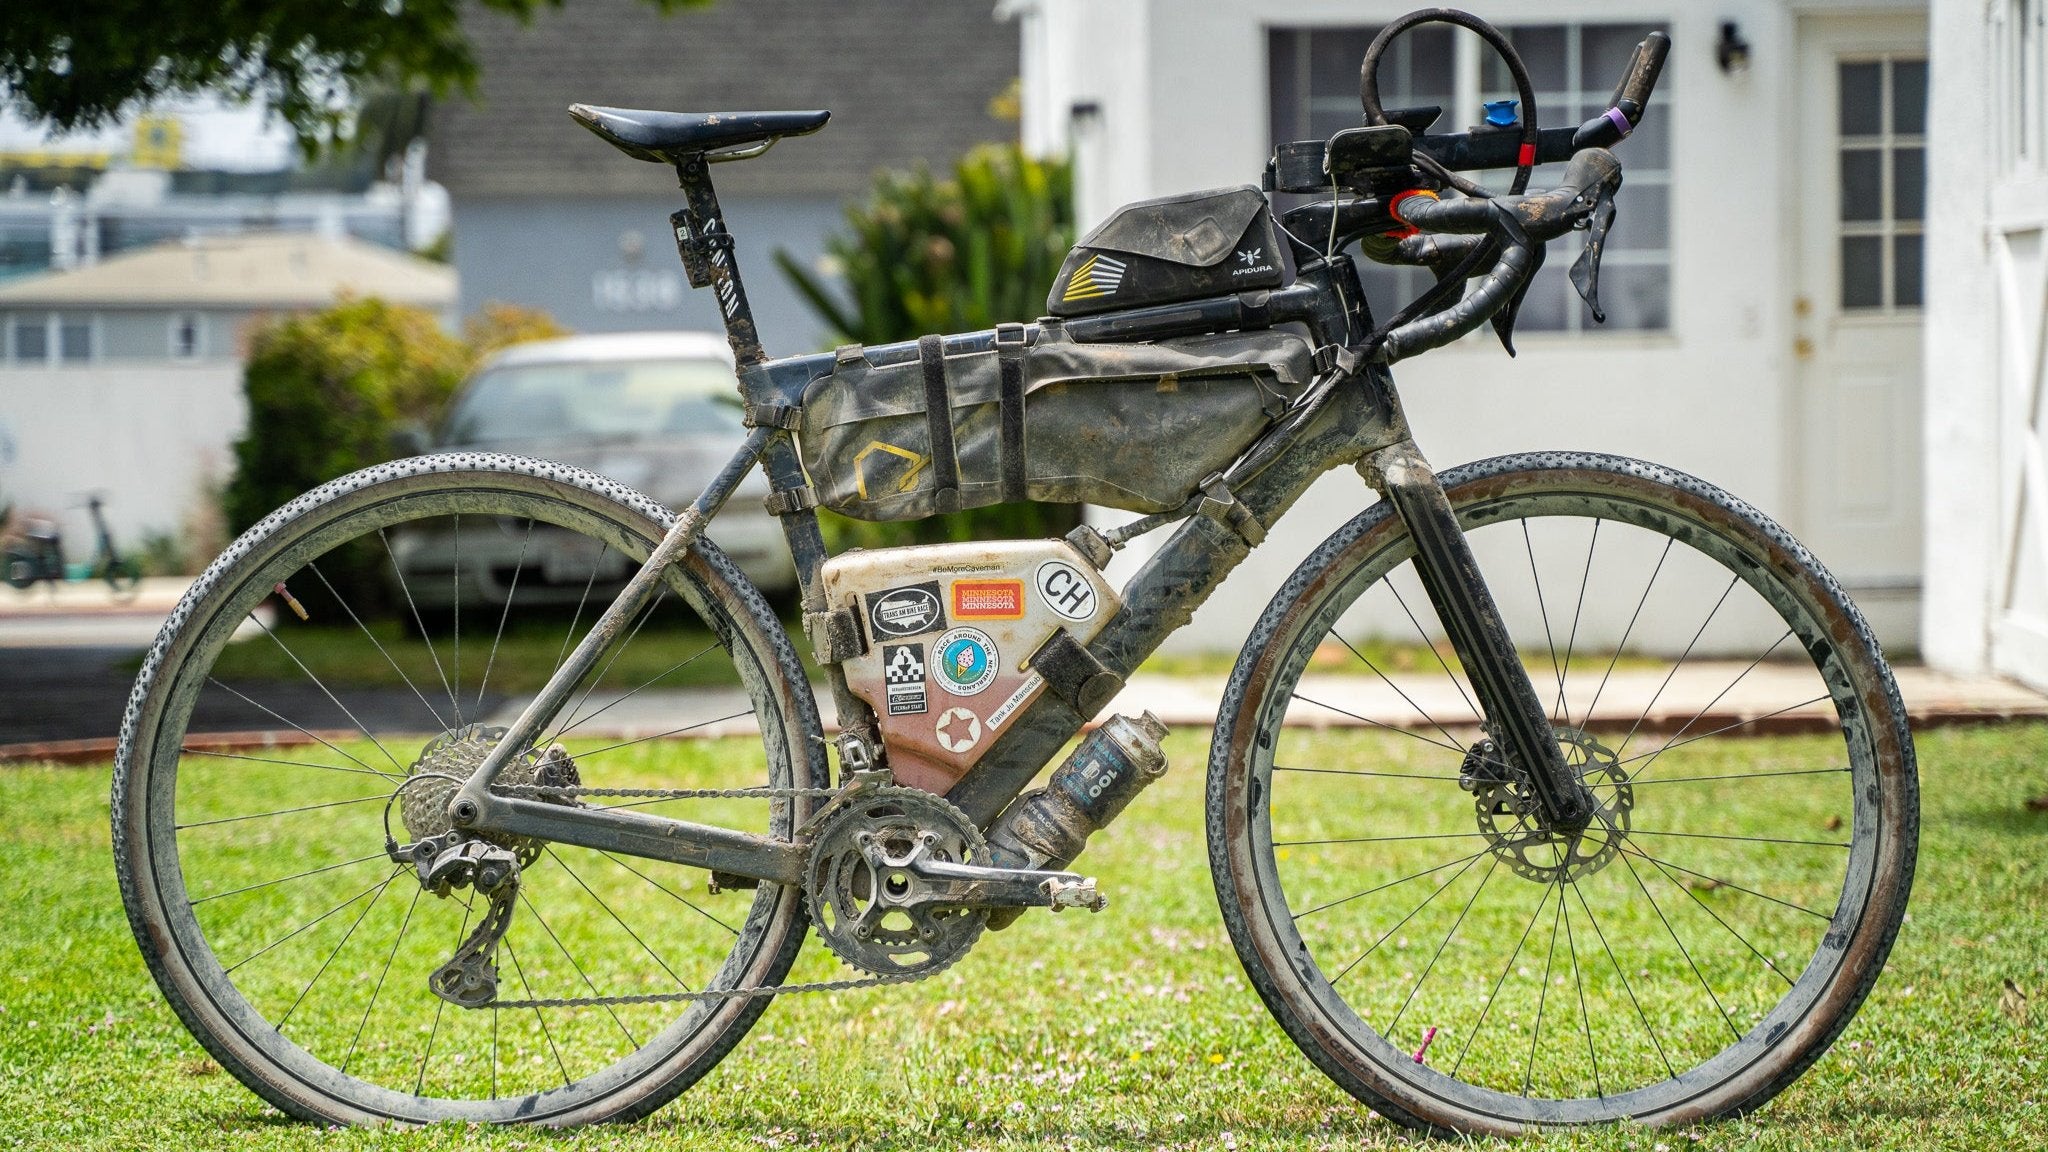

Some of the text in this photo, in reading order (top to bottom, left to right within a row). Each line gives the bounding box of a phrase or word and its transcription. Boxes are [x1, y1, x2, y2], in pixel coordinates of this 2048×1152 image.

[1232, 265, 1273, 276] APIDURA
[1046, 570, 1090, 614] CH
[884, 610, 899, 619] TRANS
[907, 607, 917, 615] BIKE
[917, 604, 929, 612] RACE
[962, 602, 1014, 610] MINNESOTA
[938, 639, 951, 655] RACE
[953, 633, 982, 643] AROUND
[983, 643, 992, 655] THE
[957, 659, 993, 691] NETHERLANDS
[990, 676, 1041, 725] Tank Ju Mansclub
[1094, 740, 1125, 771] GRAVEL
[1089, 769, 1118, 798] 100
[1037, 813, 1061, 836] GLORY
